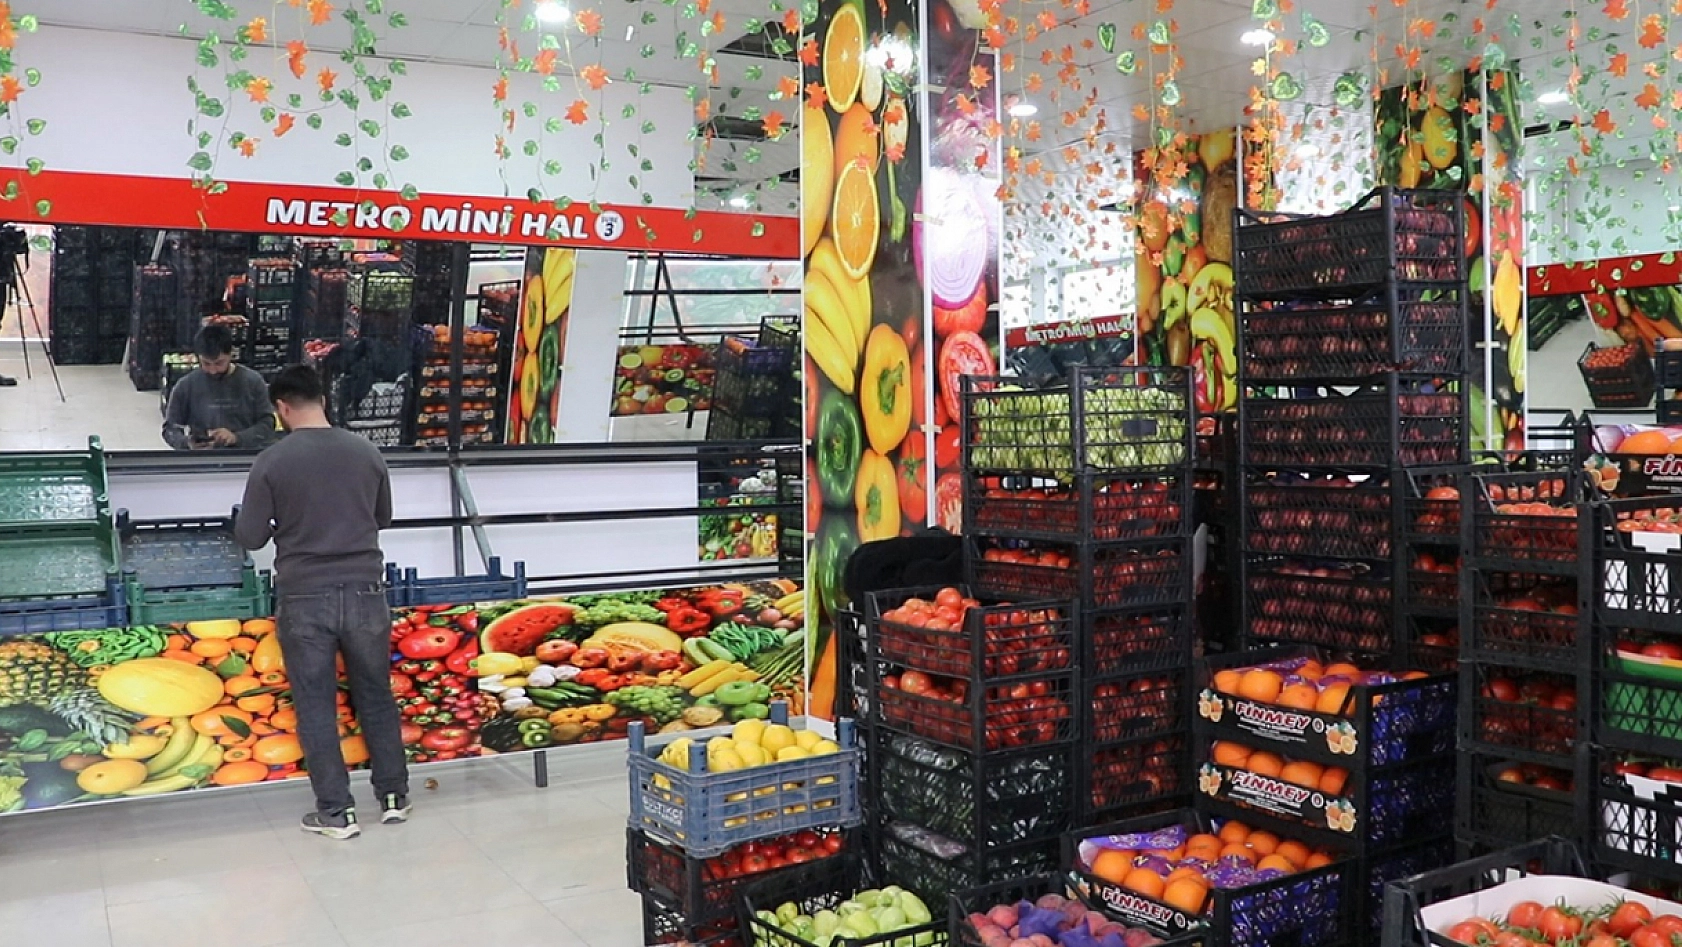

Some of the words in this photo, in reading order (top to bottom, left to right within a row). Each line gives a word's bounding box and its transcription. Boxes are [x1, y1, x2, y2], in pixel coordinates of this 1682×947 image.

[266, 199, 411, 232] METRO
[521, 212, 588, 240] HAL
[604, 222, 614, 237] 3
[1236, 701, 1311, 730] FİNMEY
[1232, 770, 1310, 802] FİNMEY
[1101, 886, 1174, 922] FİNMEY
